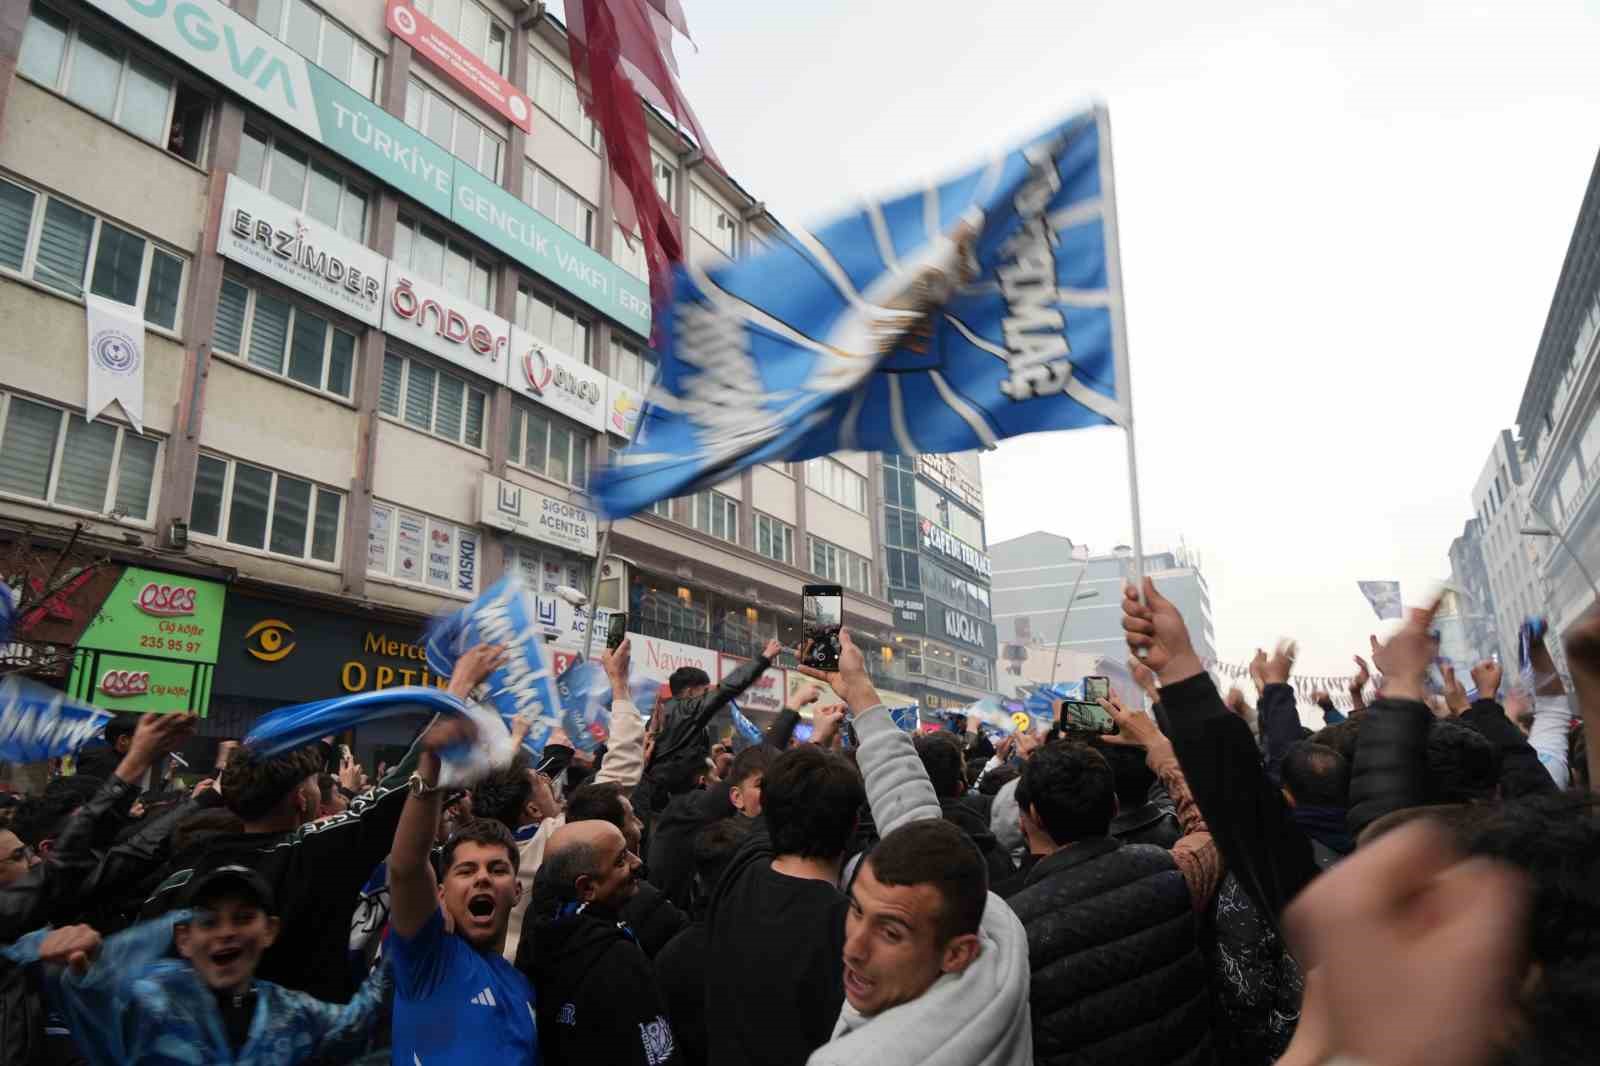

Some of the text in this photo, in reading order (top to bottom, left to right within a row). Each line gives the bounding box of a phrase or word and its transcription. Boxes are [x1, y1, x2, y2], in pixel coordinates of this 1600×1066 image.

[331, 101, 450, 194] TÜRKİYE
[231, 208, 380, 304] ERZİMDER
[539, 514, 590, 538] ACENTESİ
[459, 540, 476, 591] KASKO
[141, 635, 201, 654] 235 95 97
